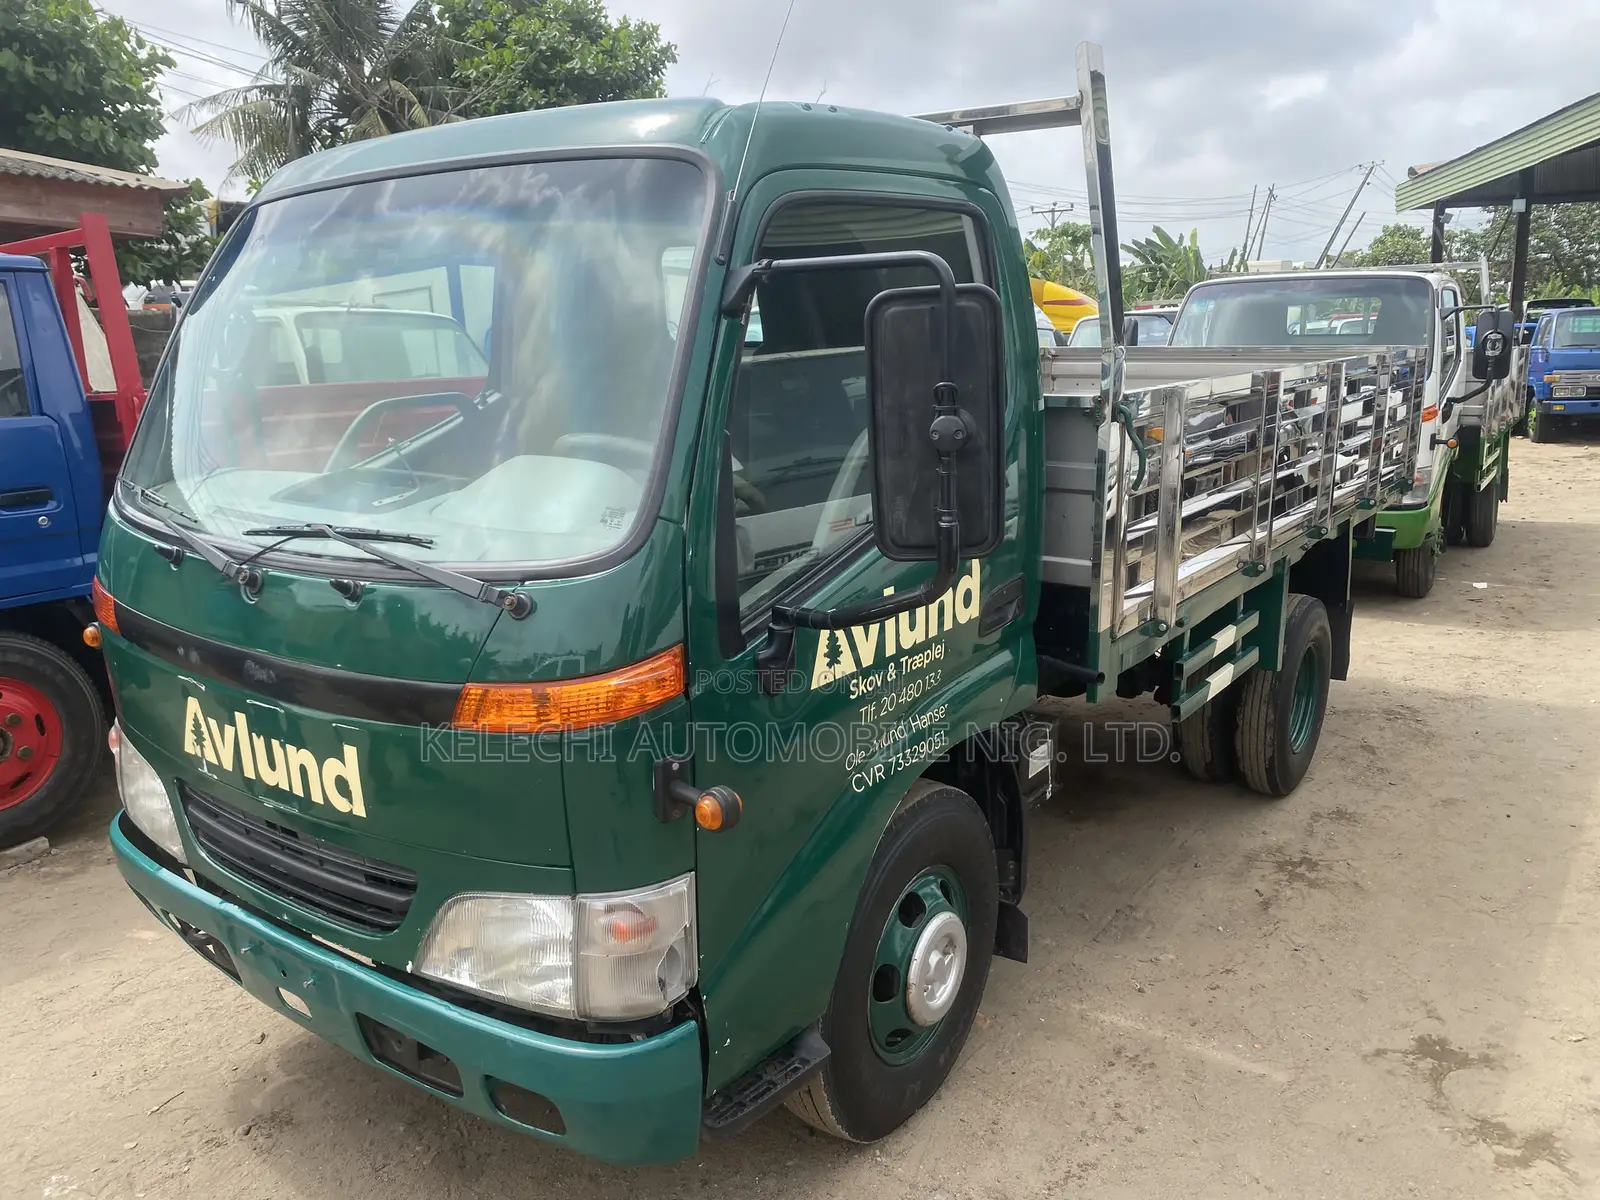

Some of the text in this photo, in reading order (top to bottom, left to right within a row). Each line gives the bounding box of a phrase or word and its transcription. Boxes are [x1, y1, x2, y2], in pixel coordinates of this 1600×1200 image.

[811, 558, 981, 690] Avlund
[849, 639, 945, 700] Skov & Træplej
[859, 701, 878, 726] Tlf.
[880, 692, 897, 717] 20
[898, 679, 923, 705] 480
[184, 696, 368, 818] Avlund
[845, 748, 866, 771] Ole
[909, 703, 949, 733] Hanse
[851, 730, 945, 793] CVR 73329051
